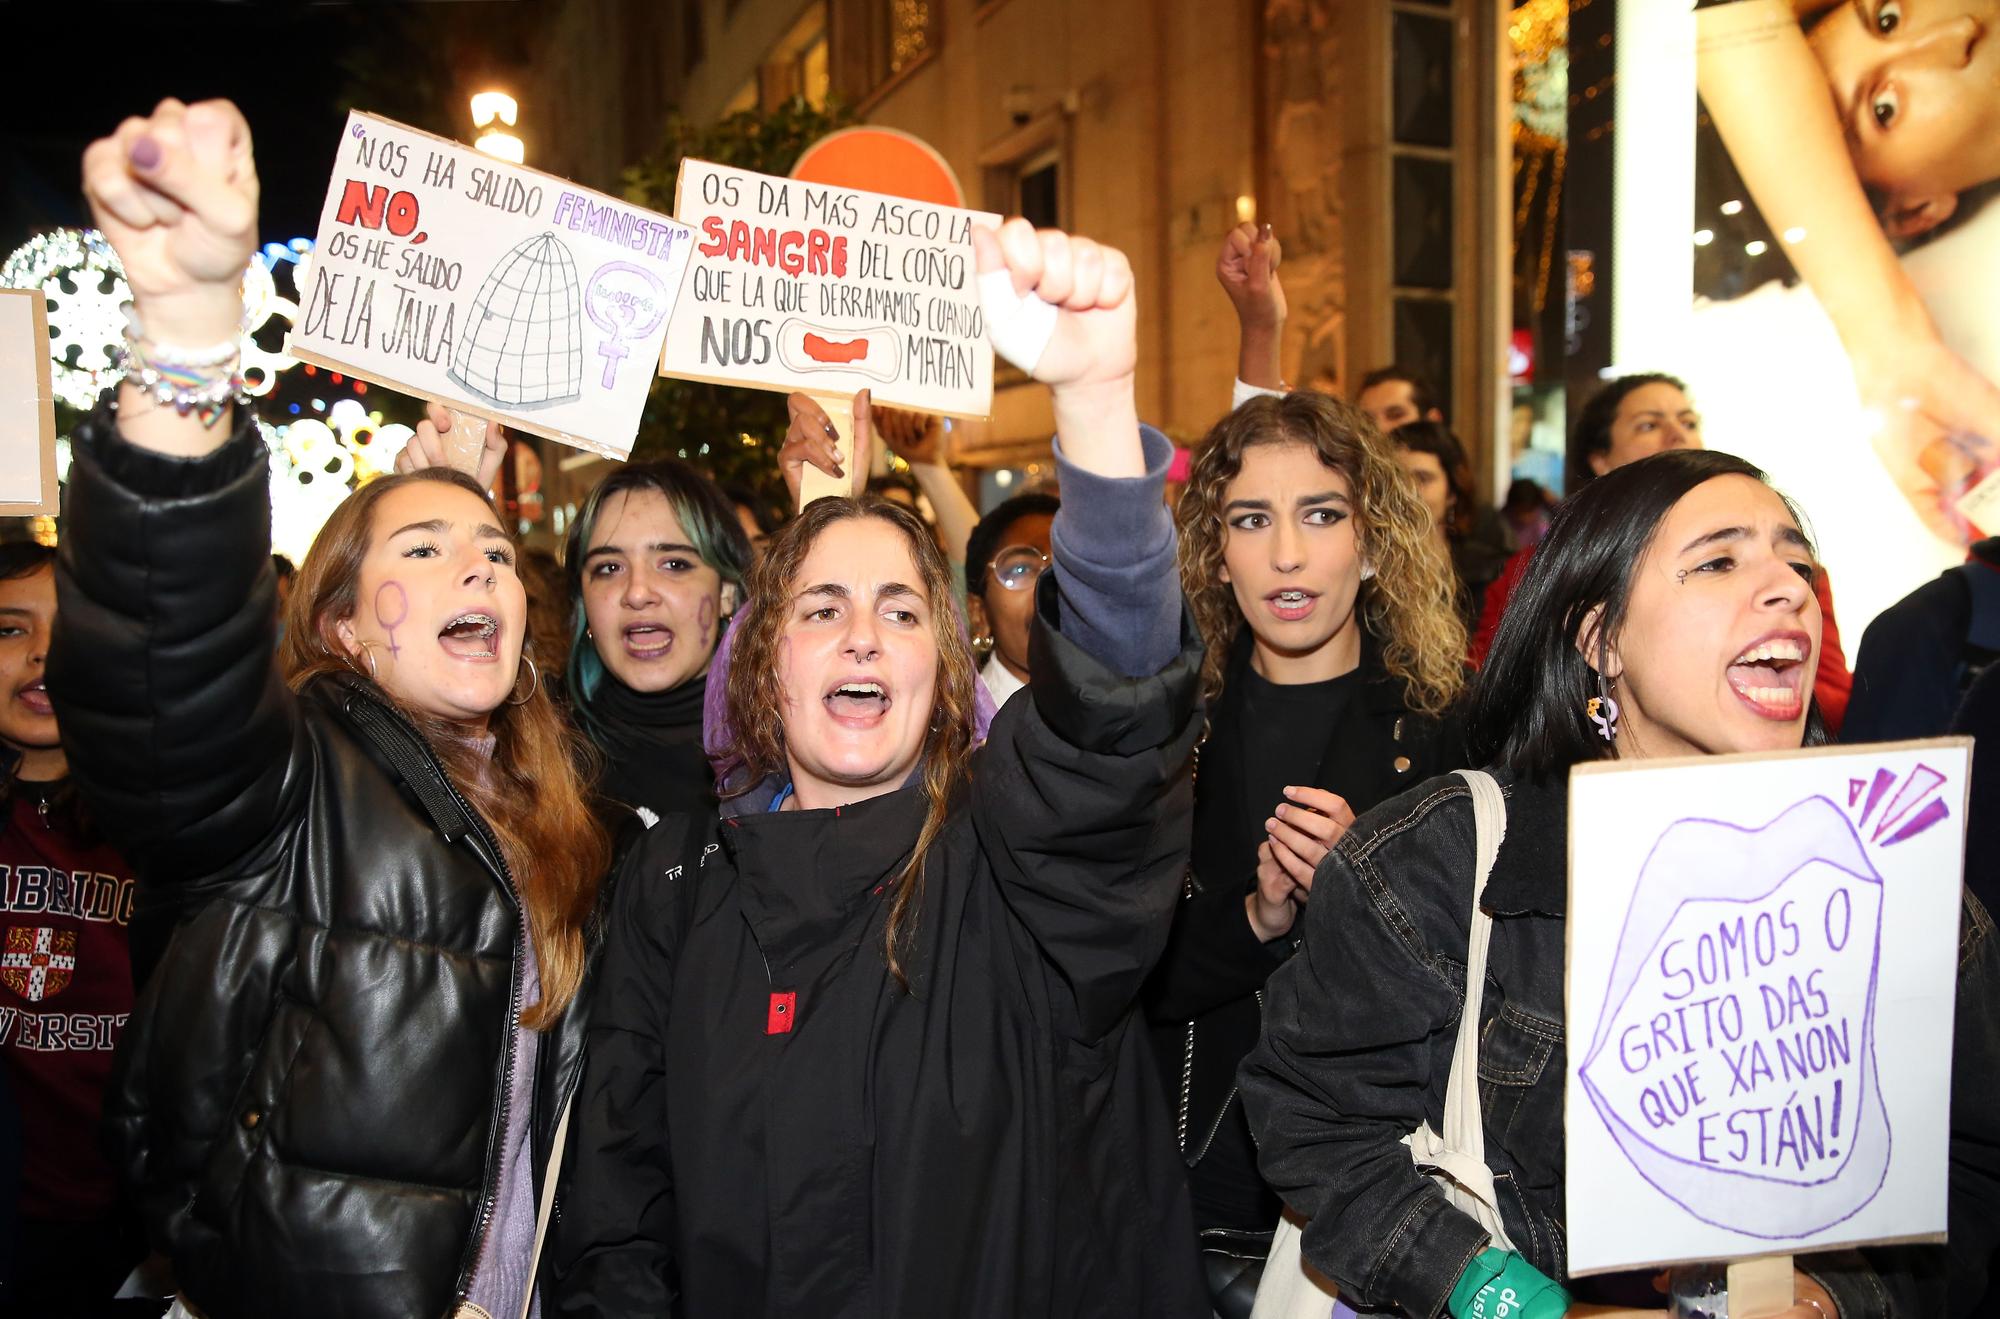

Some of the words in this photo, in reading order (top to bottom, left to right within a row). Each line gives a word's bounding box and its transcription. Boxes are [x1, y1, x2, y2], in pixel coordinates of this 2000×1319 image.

[335, 178, 428, 244] NO,
[422, 152, 456, 189] HA
[465, 167, 543, 218] SALIDO
[703, 173, 744, 207] OS
[758, 181, 790, 217] DA
[804, 188, 860, 228] MÁS
[871, 201, 940, 240] ASCO
[949, 215, 972, 246] LA
[328, 231, 359, 260] OS
[362, 239, 395, 270] HE
[395, 248, 463, 292] SALIDO
[698, 216, 848, 279] SANGRE
[859, 240, 894, 280] DEL
[902, 247, 965, 290] COÑO
[304, 265, 344, 340] DE
[341, 276, 376, 349] LA
[381, 283, 456, 367] JAULA
[693, 265, 732, 302] QUE
[742, 271, 765, 308] LA
[774, 277, 809, 313] QUE
[820, 283, 920, 328] DERRAMAMOS
[928, 297, 983, 340] CUANDO
[700, 315, 772, 367] NOS
[907, 333, 974, 390] MATAN
[1660, 900, 1800, 1000] SOMOS
[1825, 888, 1851, 951] O
[1619, 994, 1743, 1074] GRITO
[1759, 968, 1829, 1031] DAS
[1640, 1060, 1707, 1128] QUE
[1697, 1079, 1843, 1171] ESTÁN!
